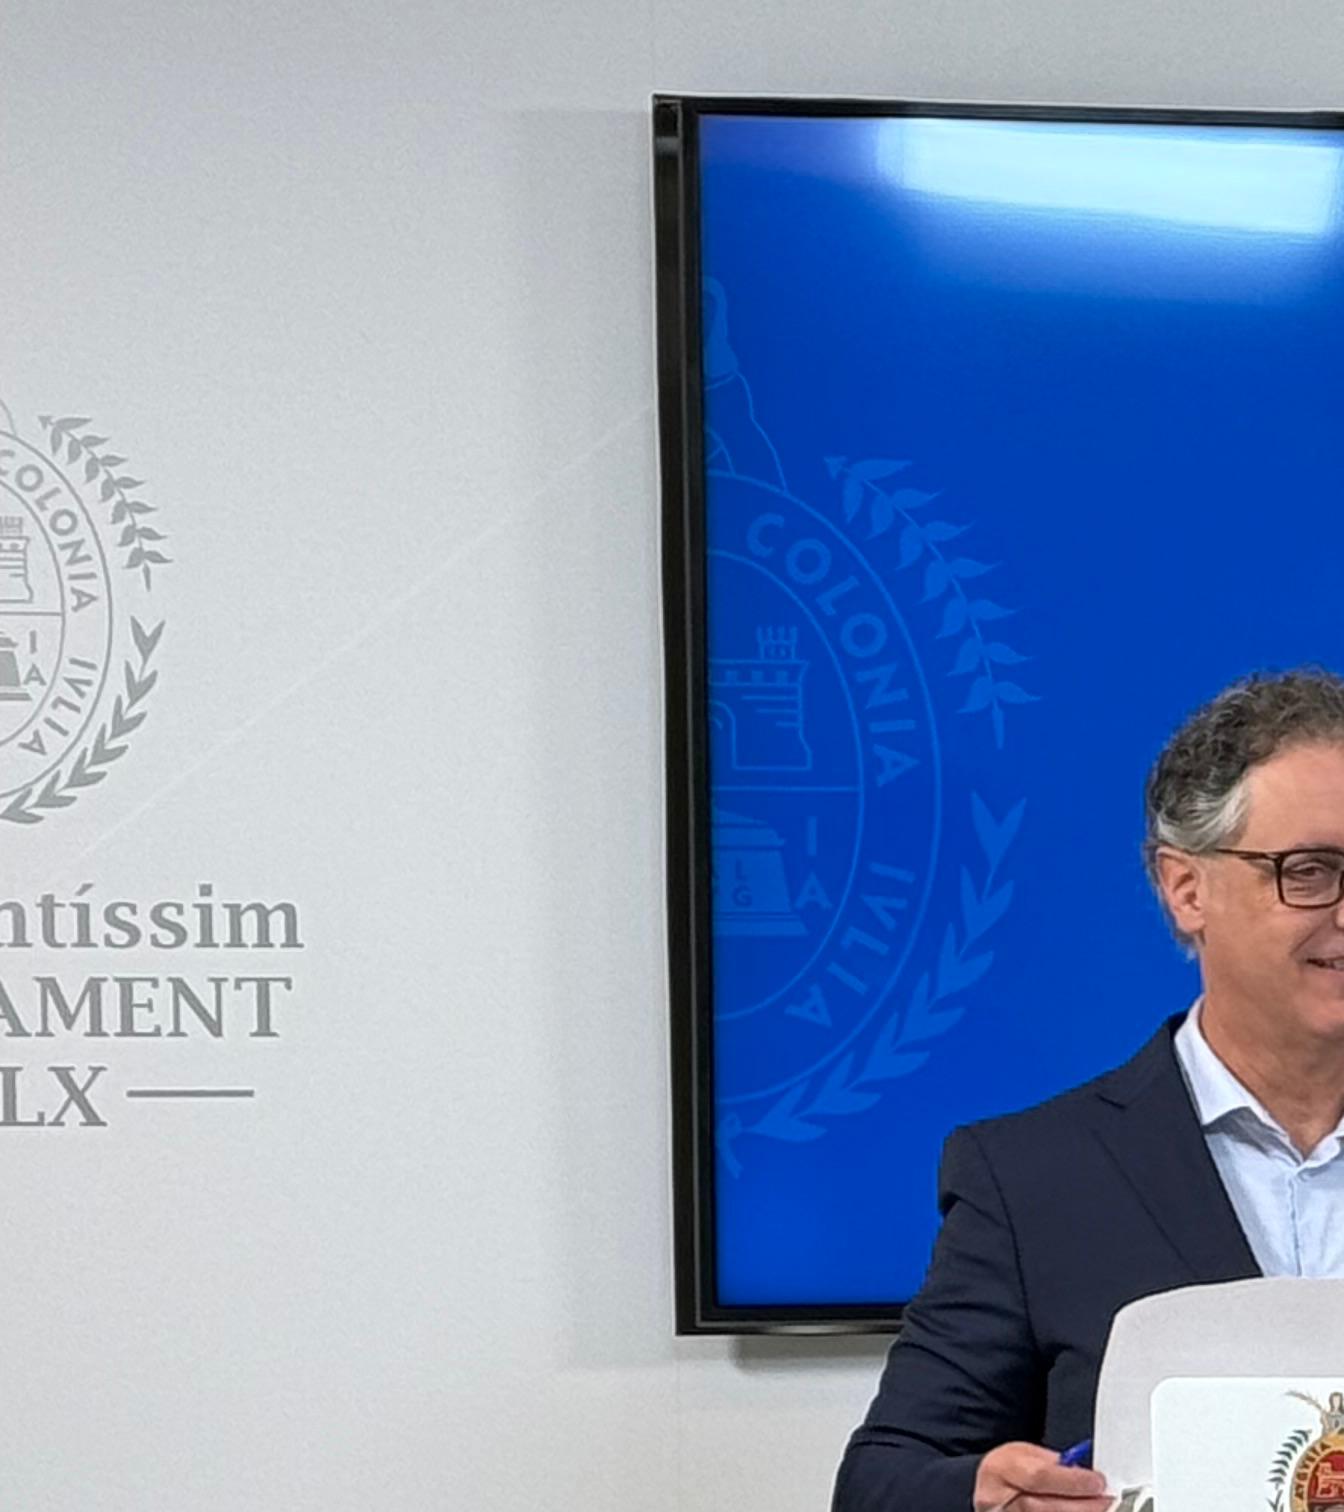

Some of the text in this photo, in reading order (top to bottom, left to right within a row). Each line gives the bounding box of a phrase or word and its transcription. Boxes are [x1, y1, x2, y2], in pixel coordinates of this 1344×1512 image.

[0, 449, 98, 612] OLONIA
[746, 513, 920, 1028] COLONIA IVLIA
